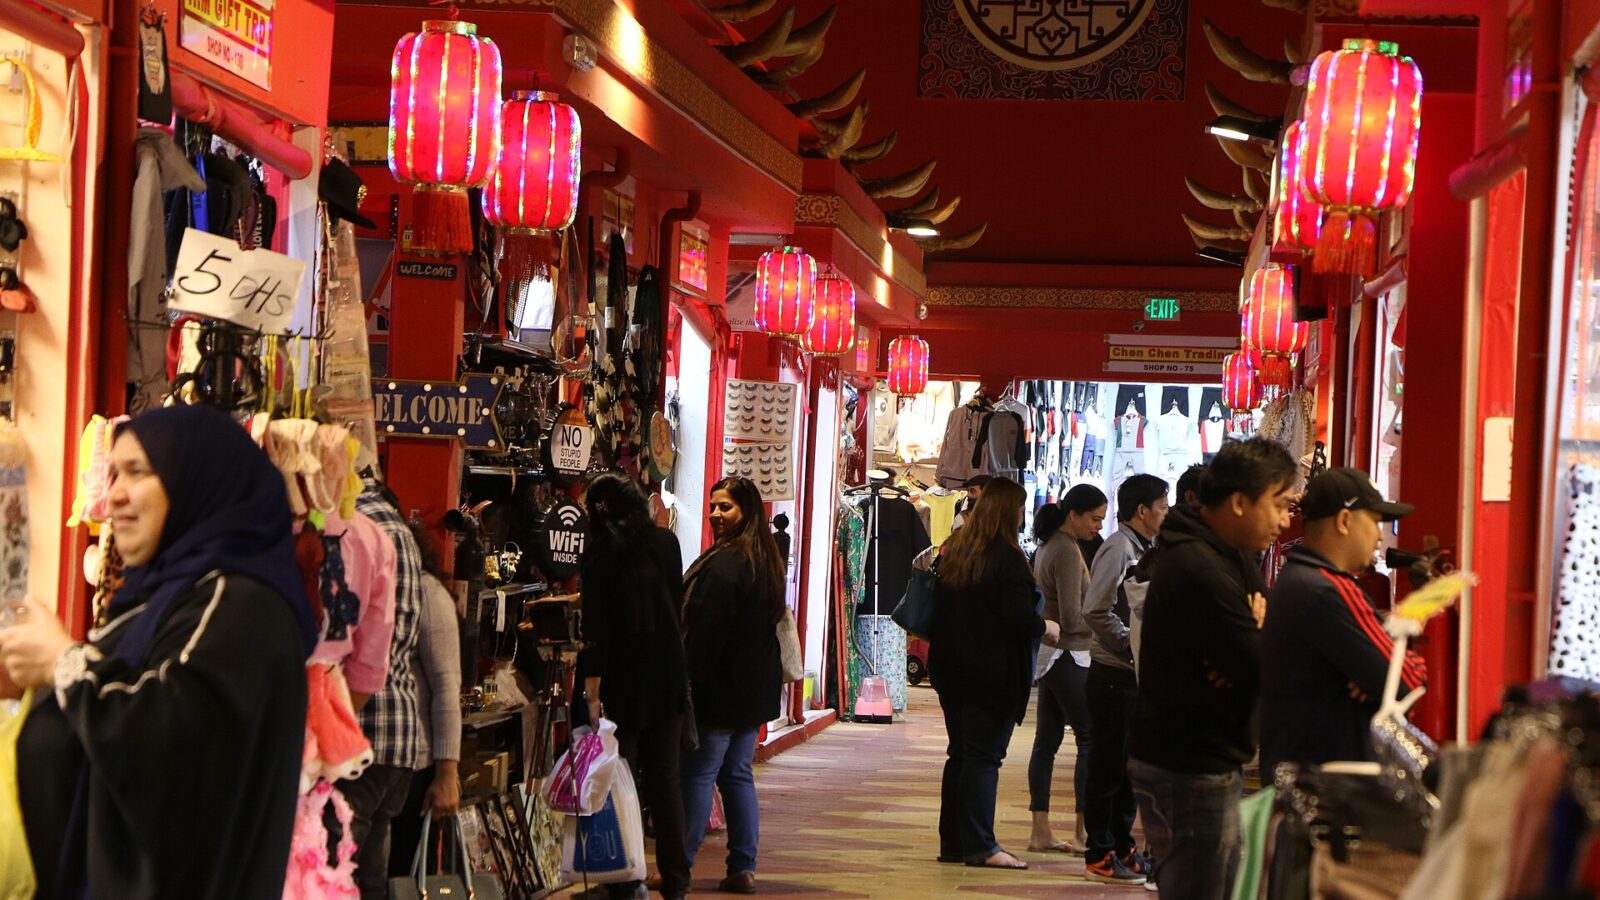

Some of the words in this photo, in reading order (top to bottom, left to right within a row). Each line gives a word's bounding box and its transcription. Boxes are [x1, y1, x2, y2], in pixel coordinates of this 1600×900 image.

[215, 0, 241, 31] GIFT
[207, 35, 221, 57] SHOP
[177, 248, 232, 295] 5
[400, 264, 455, 279] WELCOME
[1150, 299, 1176, 319] EXIT
[1143, 364, 1165, 372] SHOP
[375, 393, 484, 425] ELCOME
[561, 425, 582, 448] NO
[560, 448, 581, 459] STUPID
[560, 458, 581, 469] PEOPLE
[549, 529, 585, 554] WiFi
[552, 551, 578, 565] INSIDE
